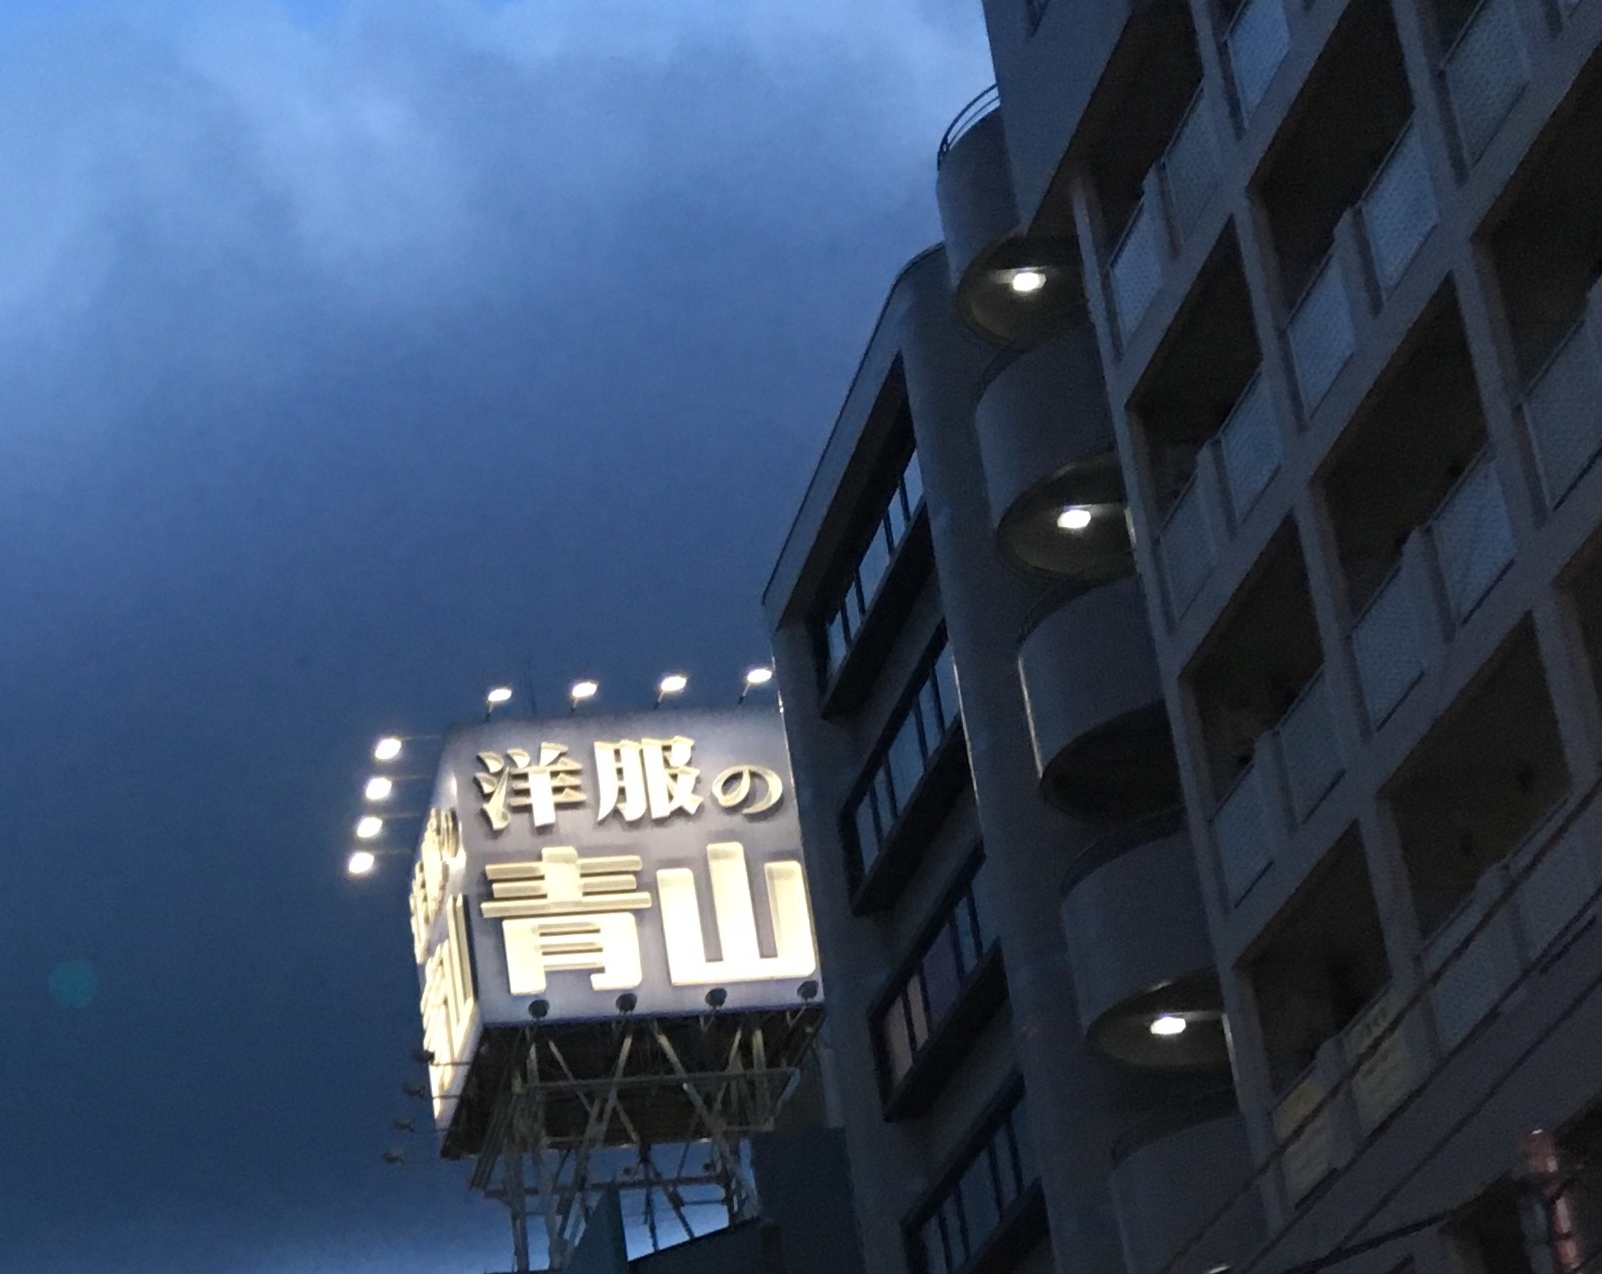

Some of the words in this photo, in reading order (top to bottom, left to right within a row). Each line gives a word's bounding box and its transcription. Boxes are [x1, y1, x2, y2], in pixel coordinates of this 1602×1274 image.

[474, 735, 783, 832] 洋服の
[479, 841, 817, 996] 青山
